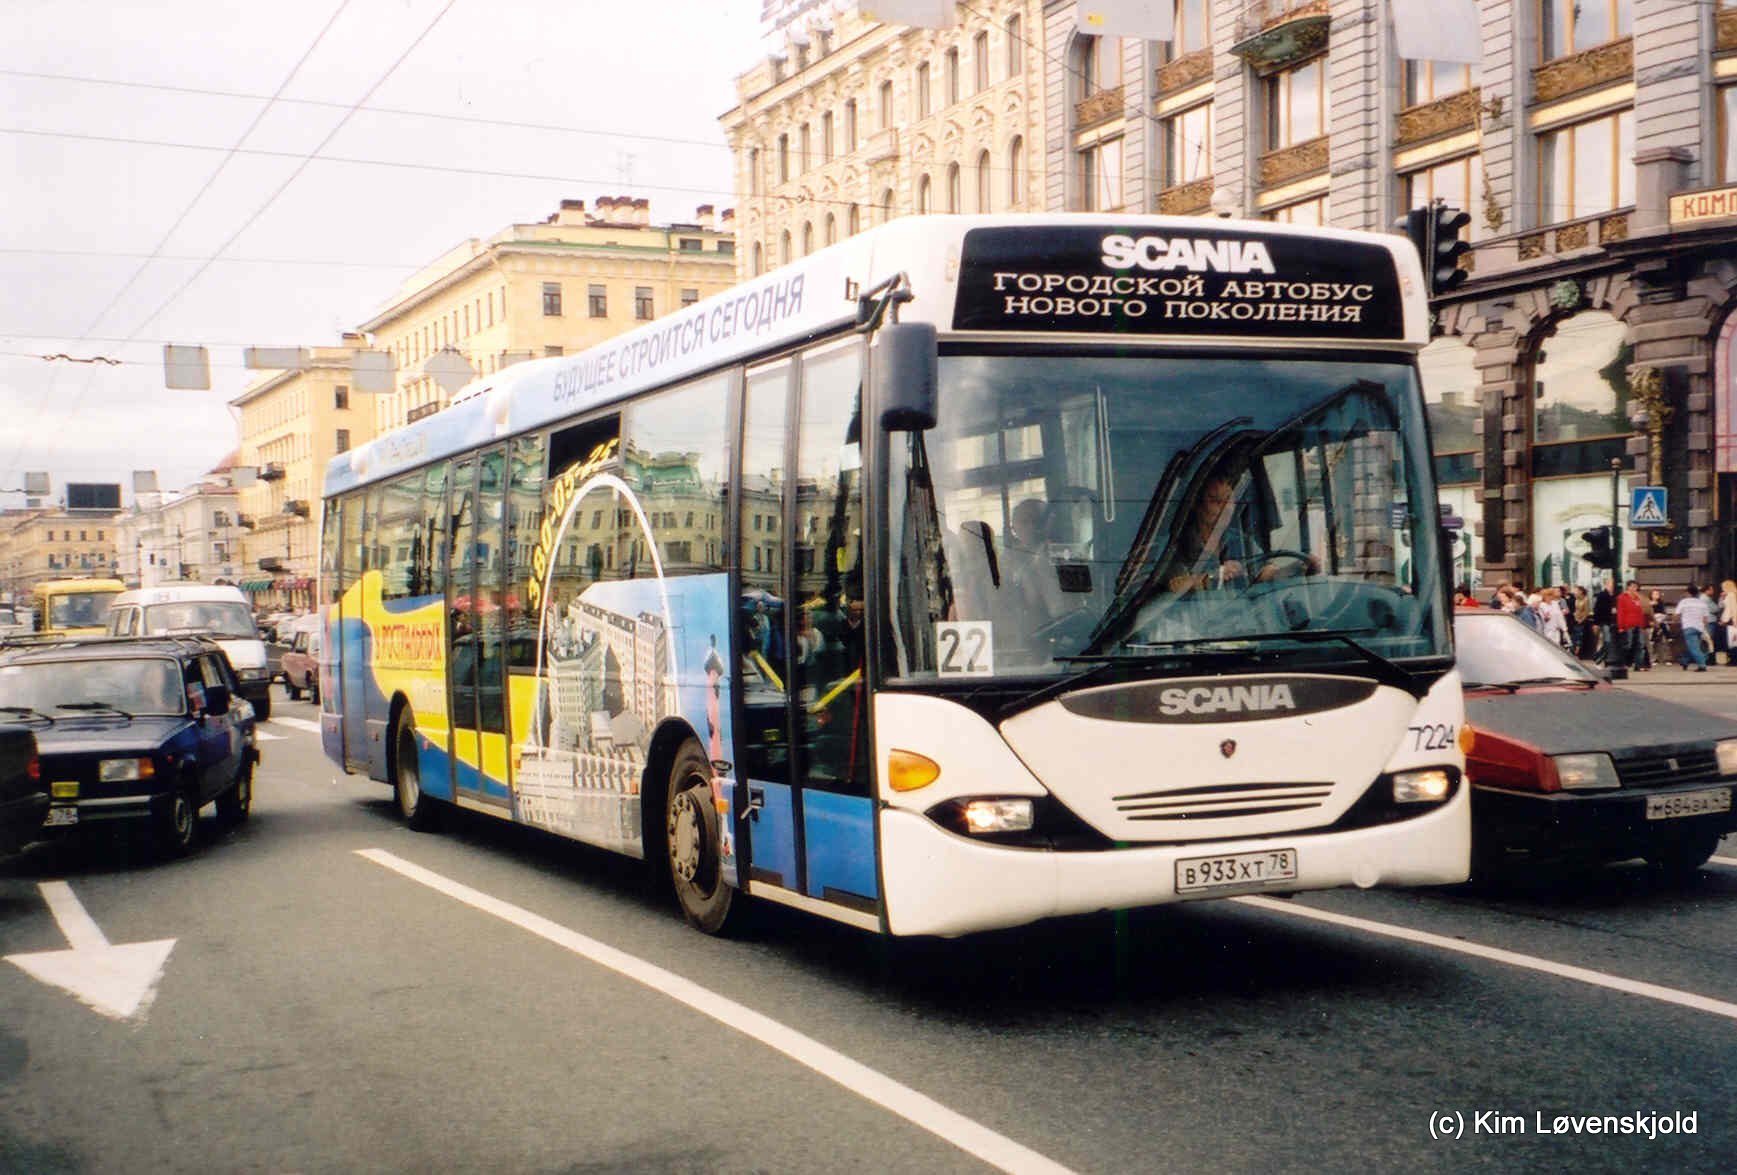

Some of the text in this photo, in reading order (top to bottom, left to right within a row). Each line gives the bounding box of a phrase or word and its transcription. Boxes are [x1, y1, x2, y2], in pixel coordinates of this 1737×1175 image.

[1101, 234, 1277, 274] SCANIA
[993, 272, 1374, 301] ГОРОДСКОЙ АВТОБУС
[1003, 296, 1362, 323] НОВОГО ПОКОЛЕНИЯ
[553, 273, 806, 402] БУДУЩЕЕ СТРОИТСЯ СЕГОДНЯ
[940, 628, 989, 673] 22
[1159, 683, 1296, 716] SCANIA
[1408, 724, 1454, 752] 7224
